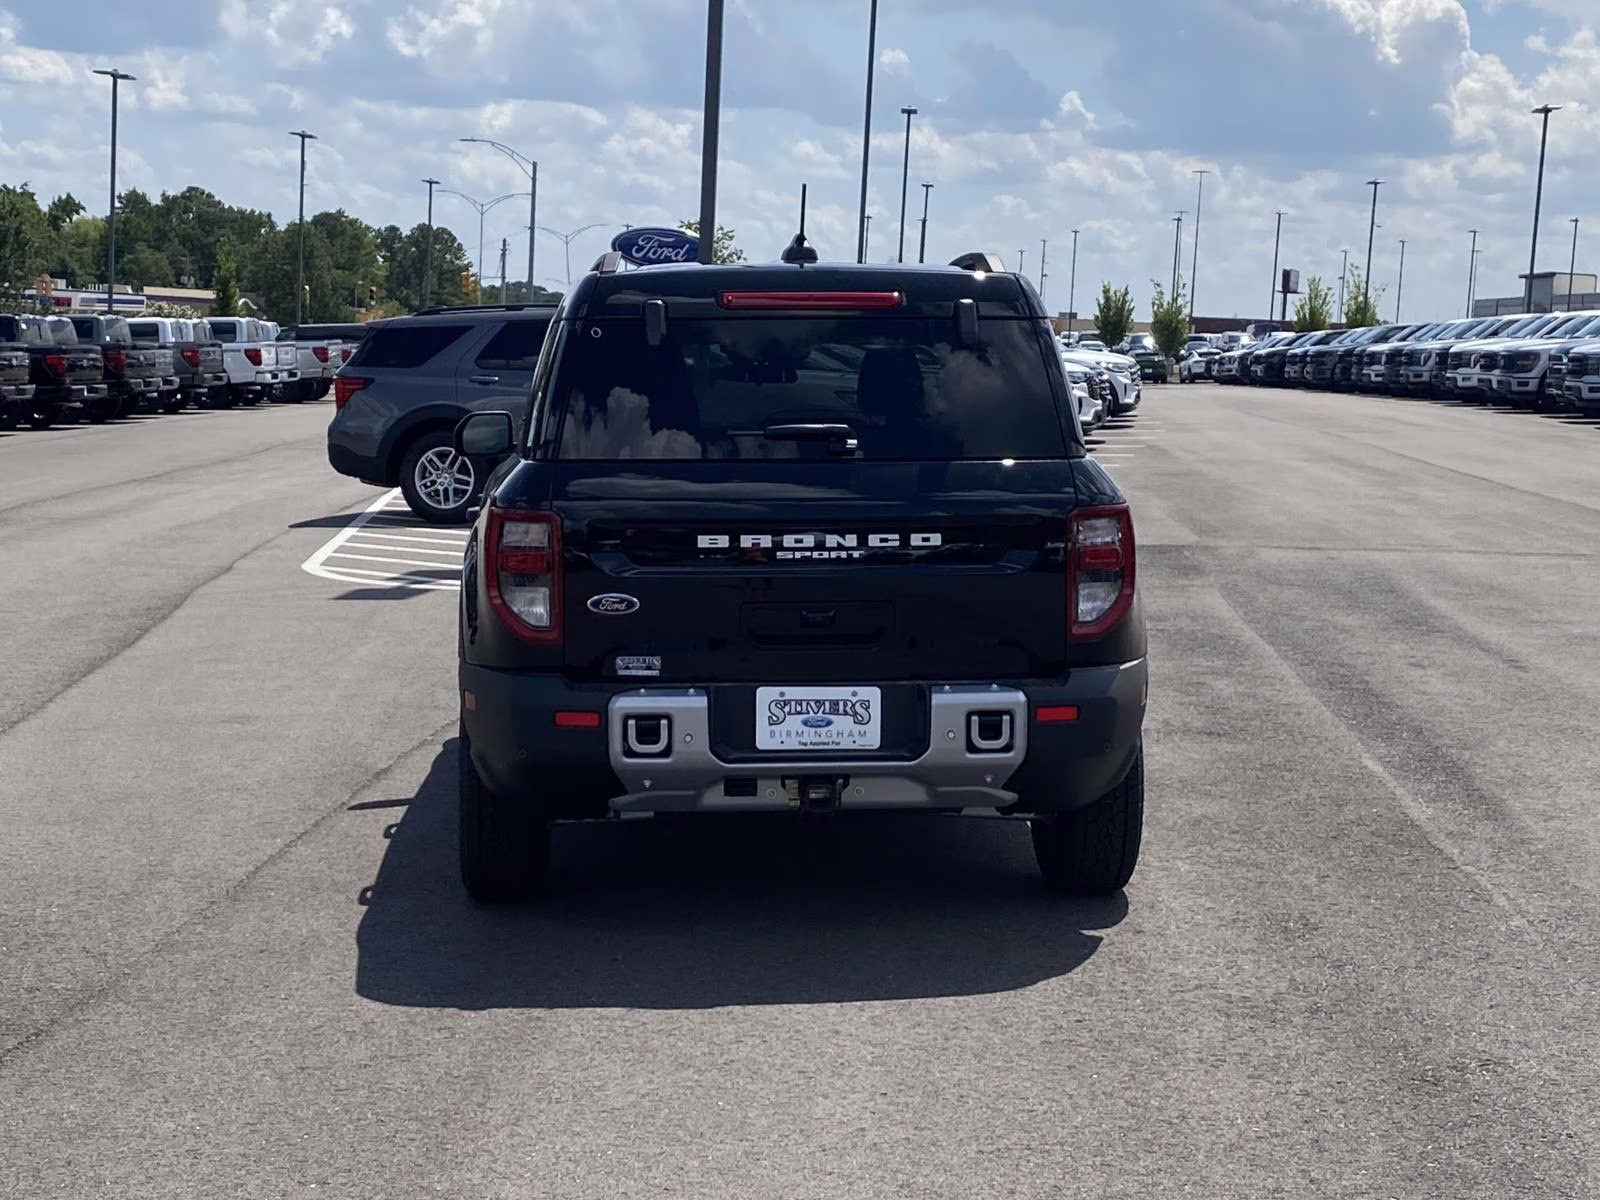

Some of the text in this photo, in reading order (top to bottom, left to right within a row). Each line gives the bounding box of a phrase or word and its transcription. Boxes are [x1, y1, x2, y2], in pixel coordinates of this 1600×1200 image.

[632, 234, 690, 261] Ford
[697, 533, 942, 548] BRONCO
[776, 551, 864, 559] SPORT
[599, 597, 628, 610] Ford
[767, 698, 872, 726] STIVERS
[769, 729, 867, 739] BIRMINGHAM
